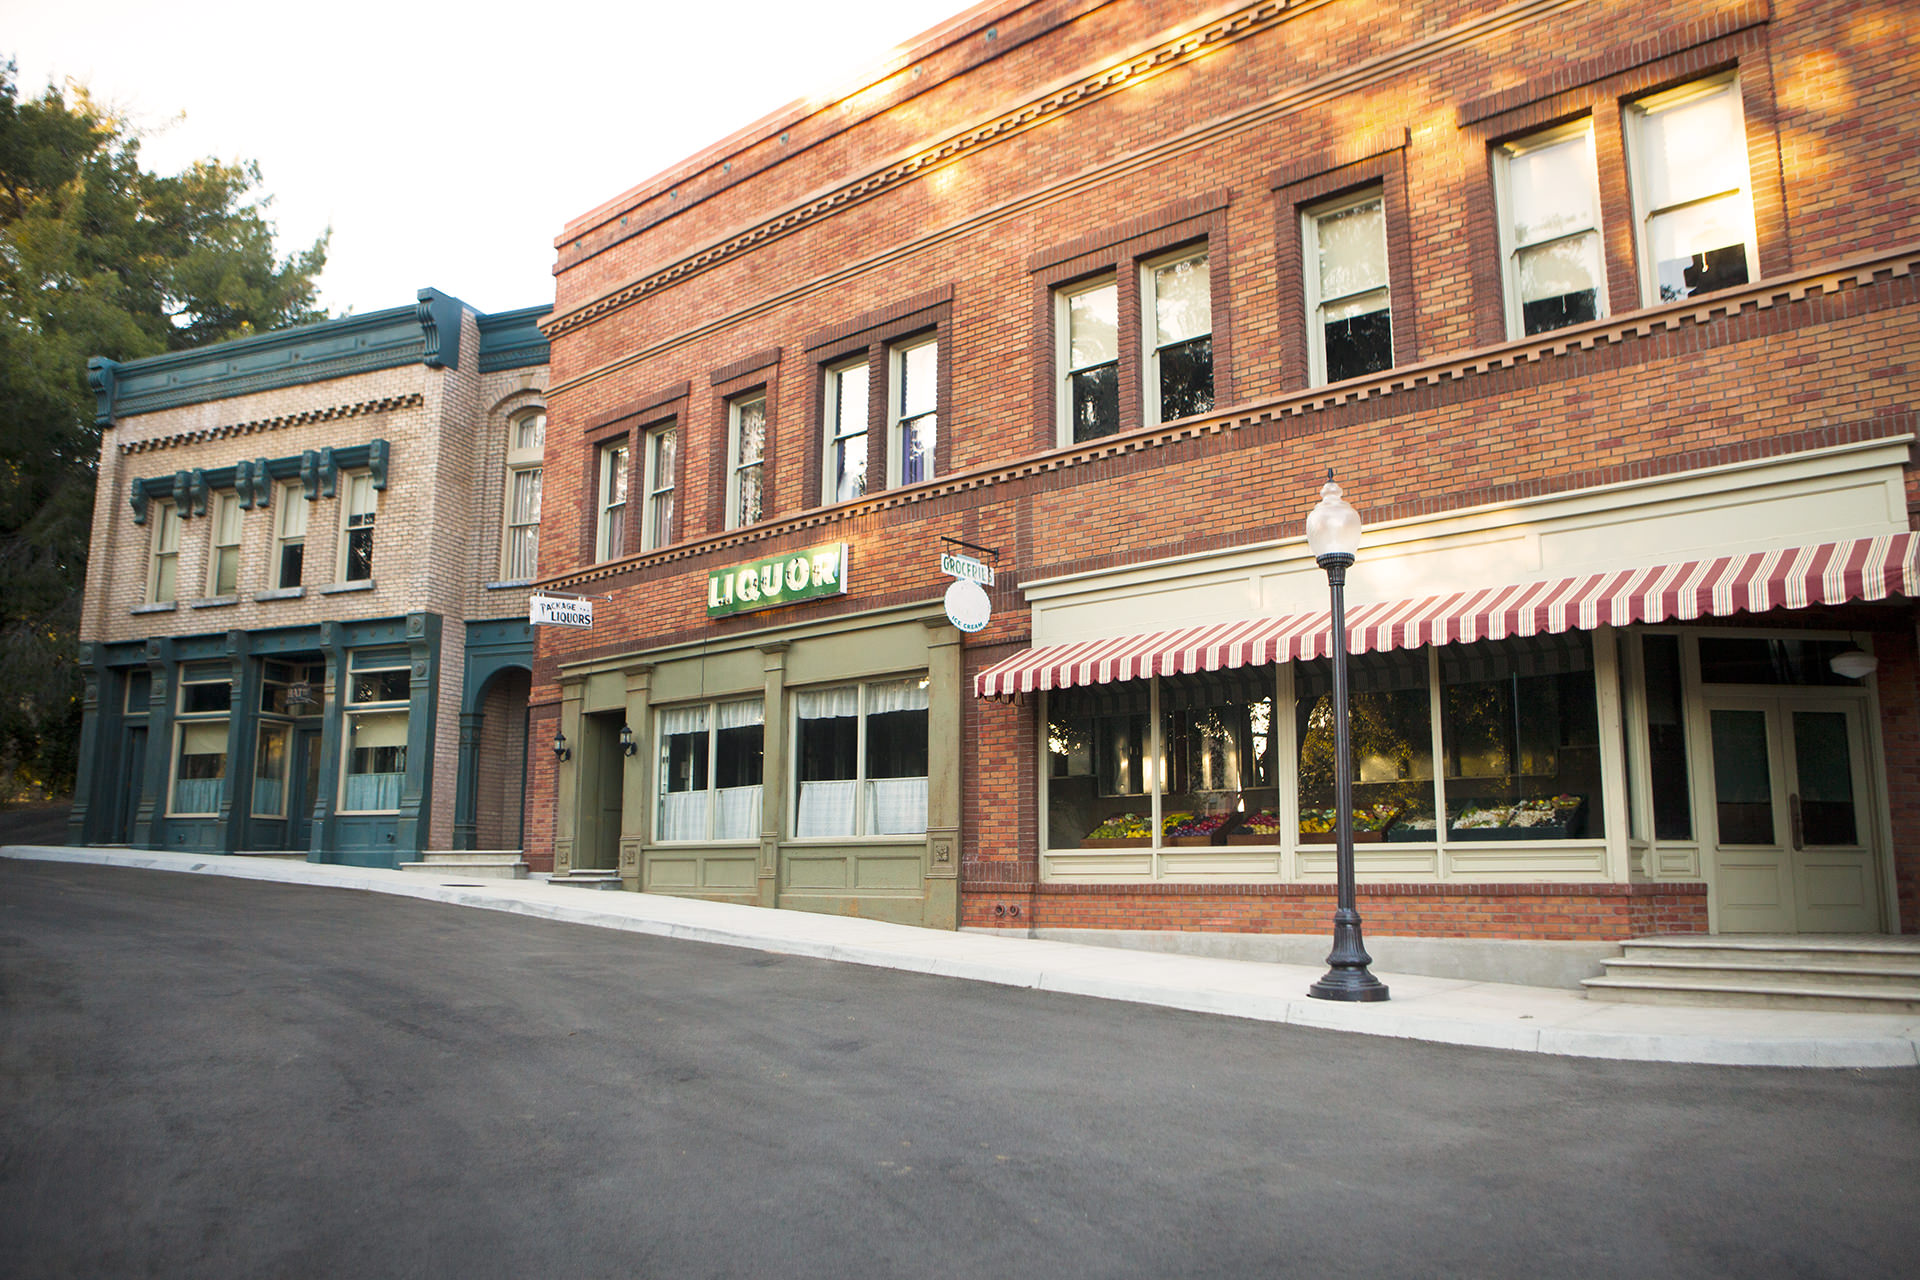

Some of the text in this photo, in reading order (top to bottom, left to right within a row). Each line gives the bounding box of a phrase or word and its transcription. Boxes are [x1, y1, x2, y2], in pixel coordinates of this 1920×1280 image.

[708, 552, 837, 608] LIQUOR
[540, 602, 576, 615] PACKAGE
[551, 611, 591, 624] LIQUORS
[951, 615, 983, 630] ICE CREAM
